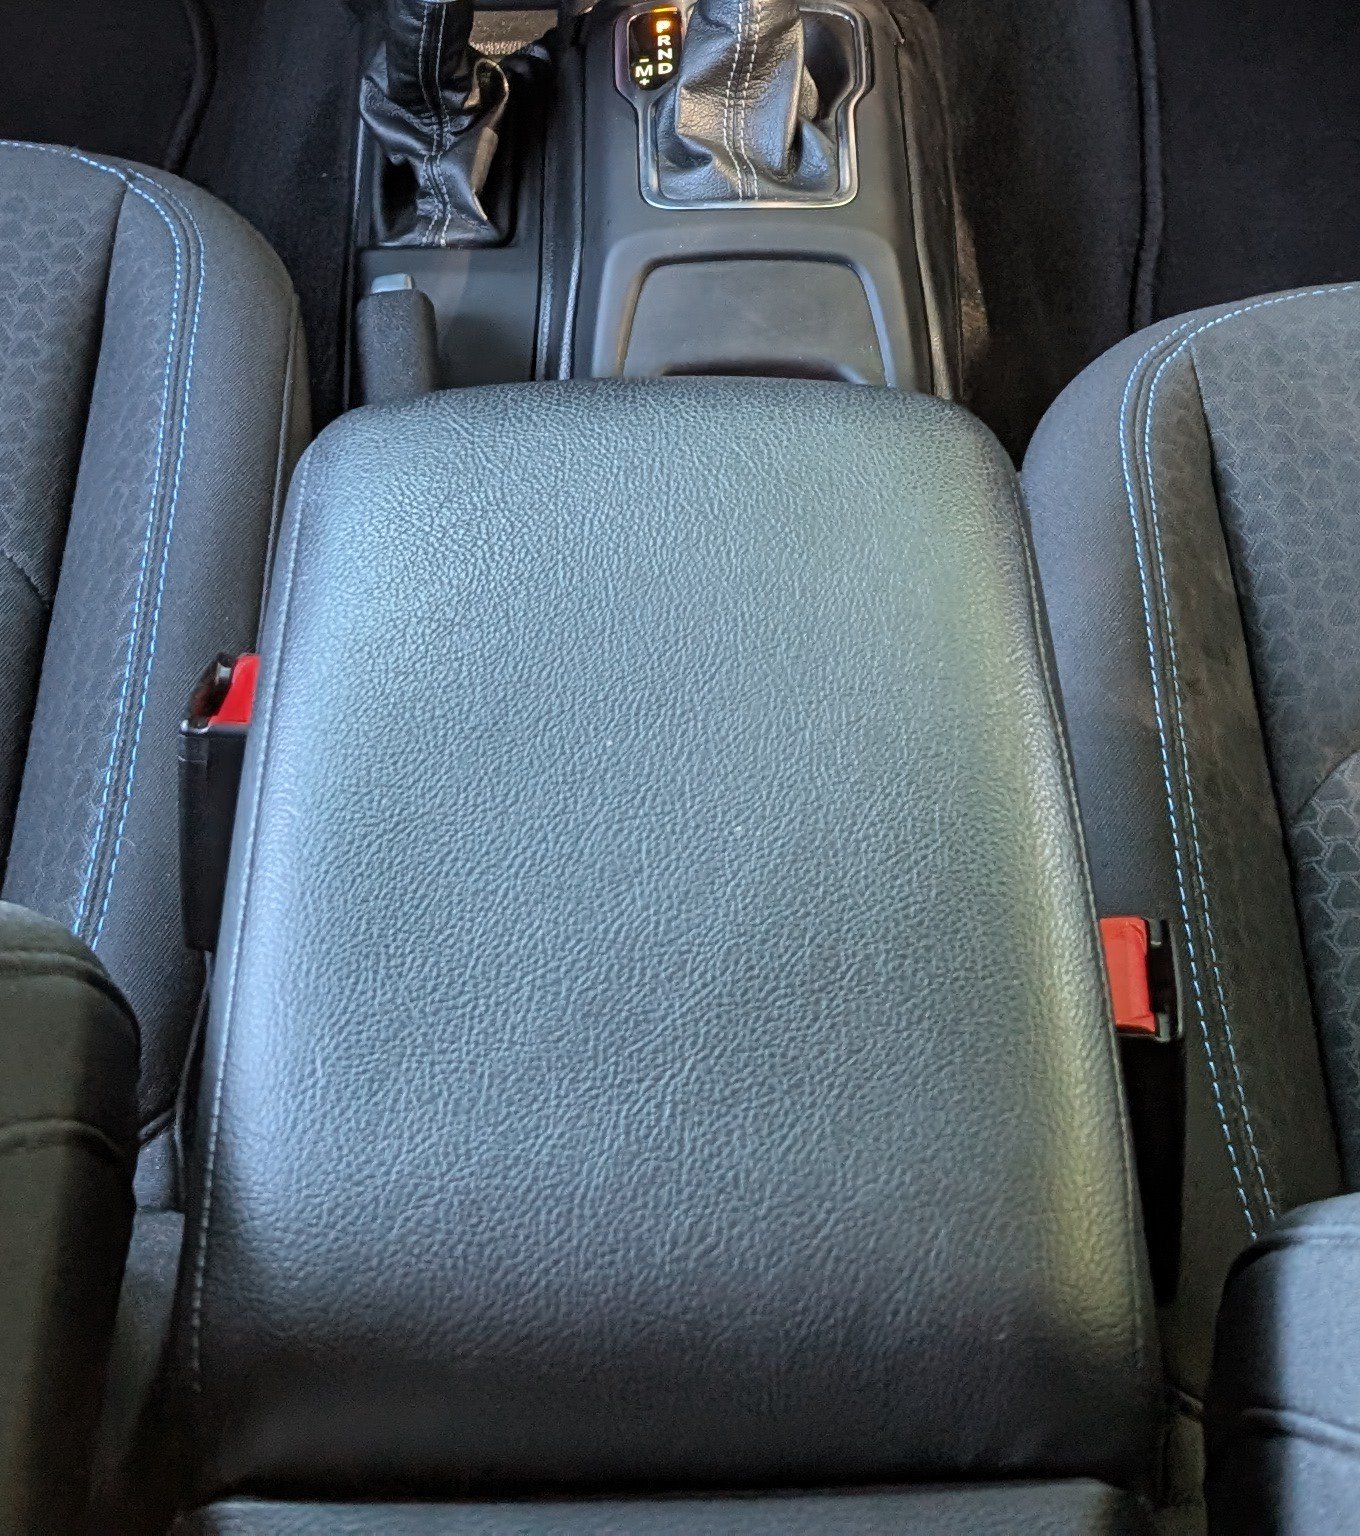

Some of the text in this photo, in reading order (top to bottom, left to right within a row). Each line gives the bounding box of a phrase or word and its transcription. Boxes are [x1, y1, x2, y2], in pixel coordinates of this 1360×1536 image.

[656, 20, 671, 34] P
[657, 34, 672, 47] R
[658, 48, 672, 60] N
[634, 64, 654, 78] M
[658, 62, 673, 75] D
